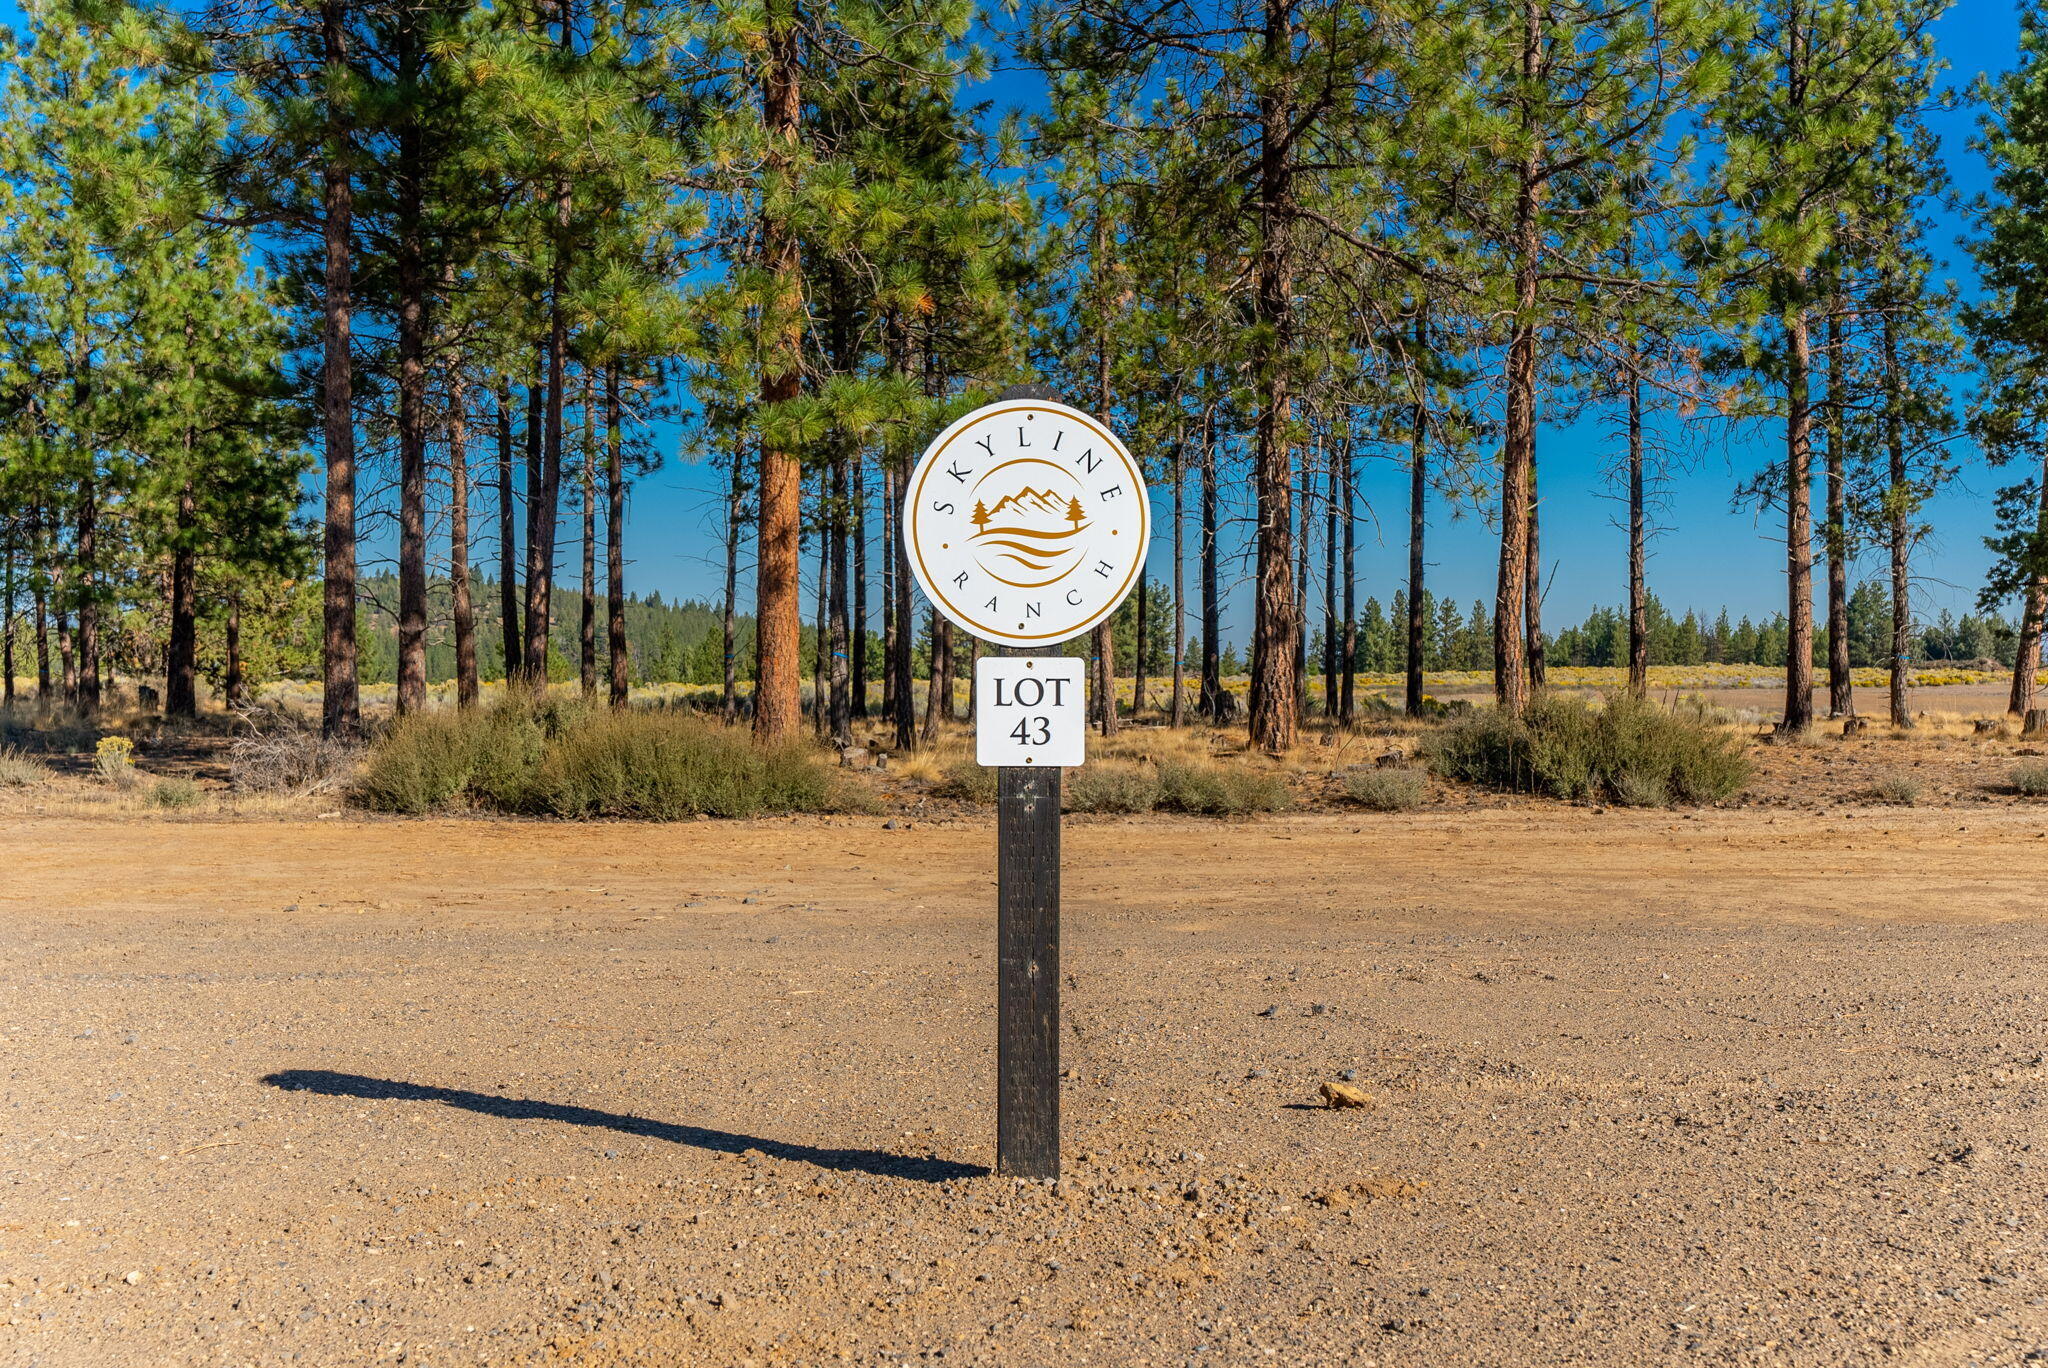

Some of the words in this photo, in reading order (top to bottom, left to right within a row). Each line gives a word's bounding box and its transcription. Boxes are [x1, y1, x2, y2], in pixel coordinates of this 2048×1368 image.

[933, 426, 1122, 515] SKYLINE
[953, 560, 1114, 618] RANCH
[993, 678, 1071, 707] LOT
[1009, 716, 1051, 746] 43
